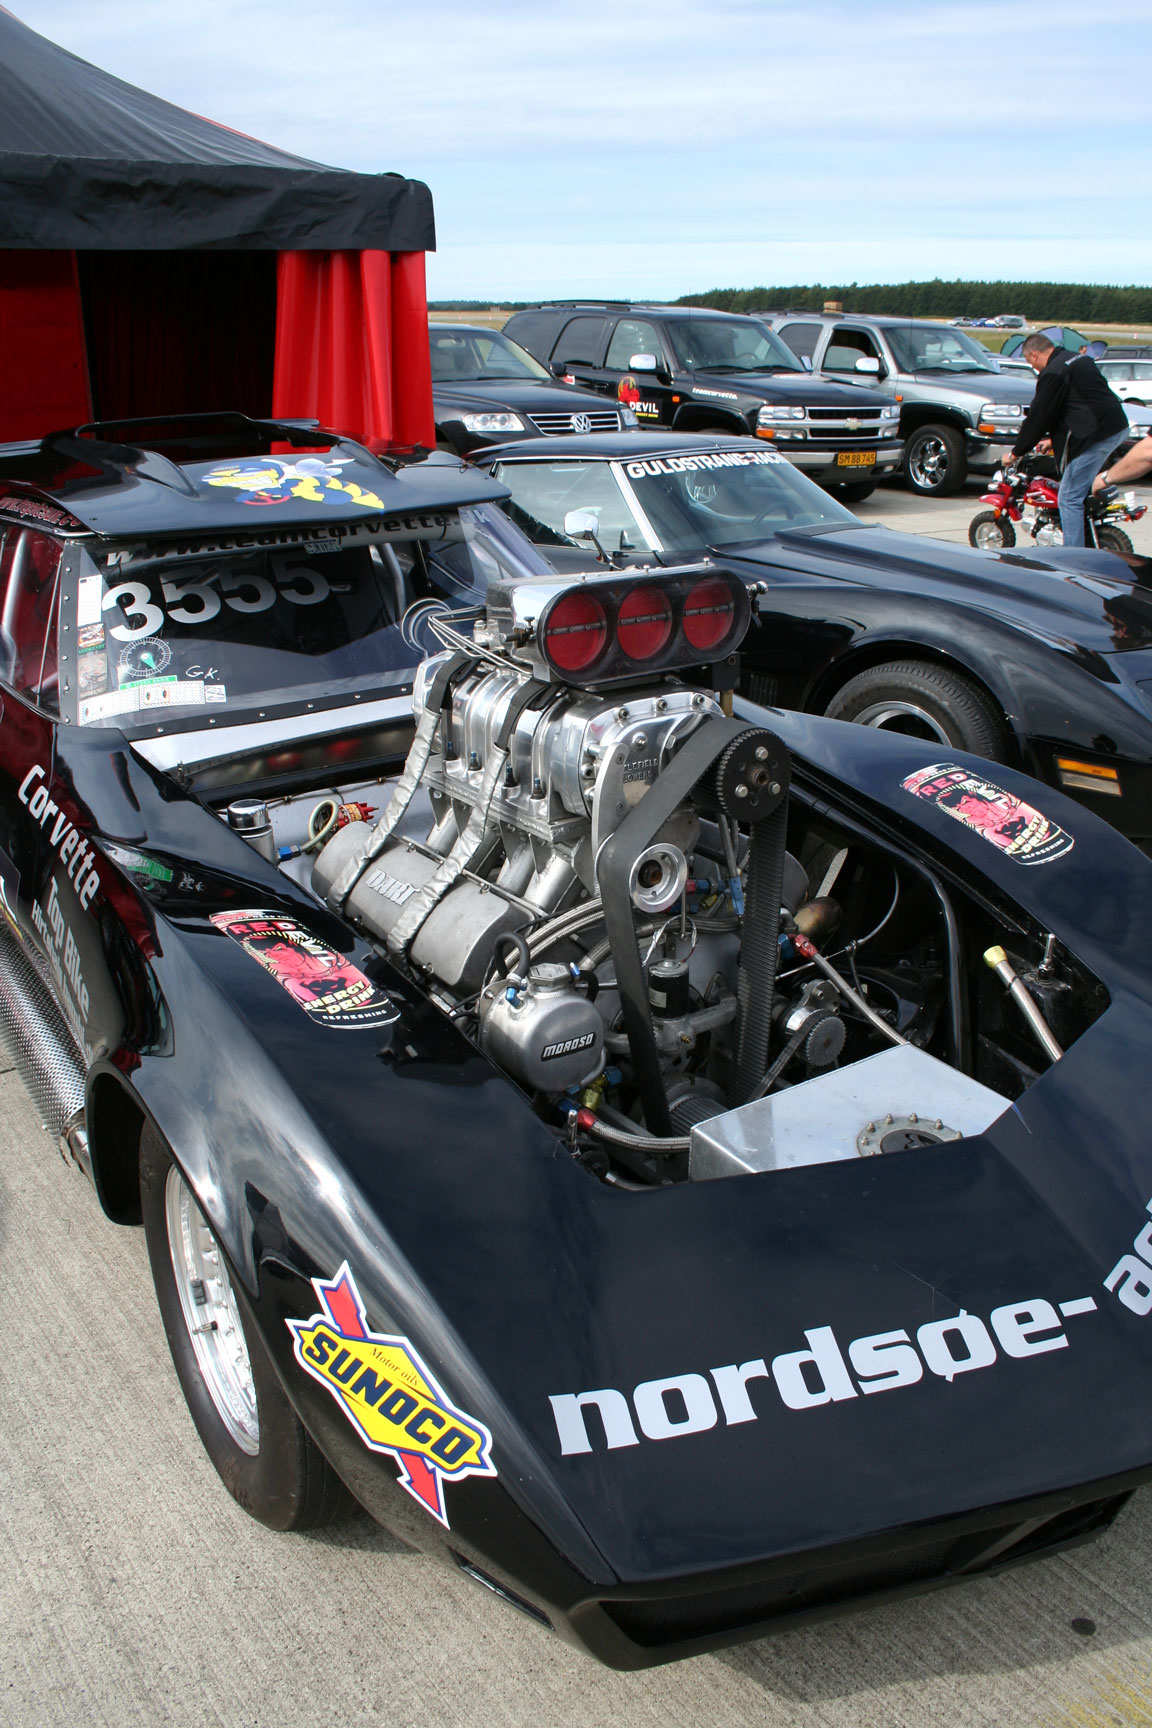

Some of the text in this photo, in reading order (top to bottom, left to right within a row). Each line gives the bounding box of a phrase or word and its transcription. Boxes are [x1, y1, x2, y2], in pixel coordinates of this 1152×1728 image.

[629, 401, 659, 414] DEVIL
[17, 764, 100, 911] Corvette
[228, 921, 297, 936] RED
[303, 980, 365, 1011] ENERGY
[326, 985, 376, 1014] DRINK
[542, 1033, 594, 1058] MOROSO
[369, 1347, 418, 1386] Motor oils
[548, 1296, 1098, 1456] nordsøe-
[305, 1331, 476, 1465] SUNOCO
